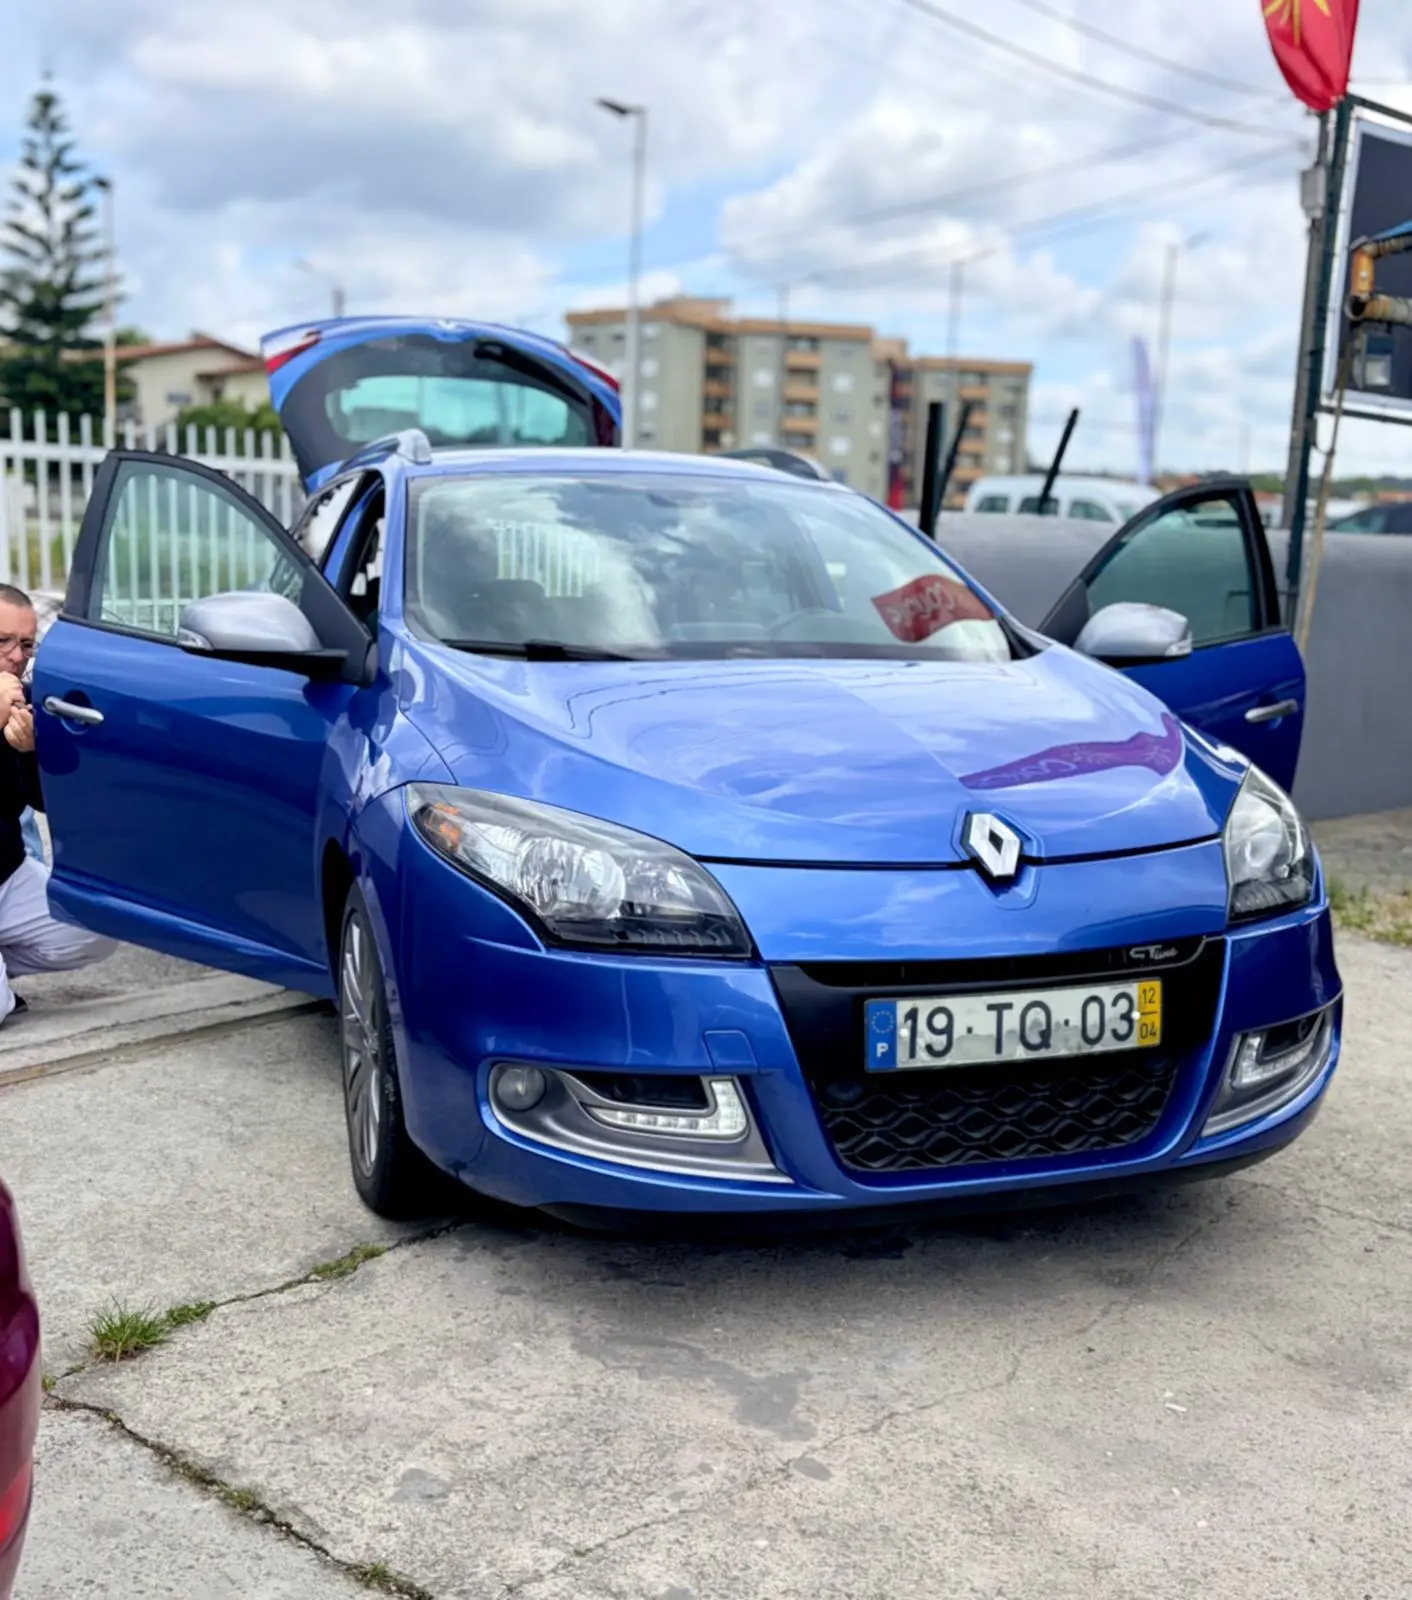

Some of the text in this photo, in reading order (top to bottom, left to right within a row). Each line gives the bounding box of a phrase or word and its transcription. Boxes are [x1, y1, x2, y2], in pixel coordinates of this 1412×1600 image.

[1142, 987, 1156, 1004] 12
[1140, 1022, 1157, 1039] 04
[876, 1041, 889, 1058] P
